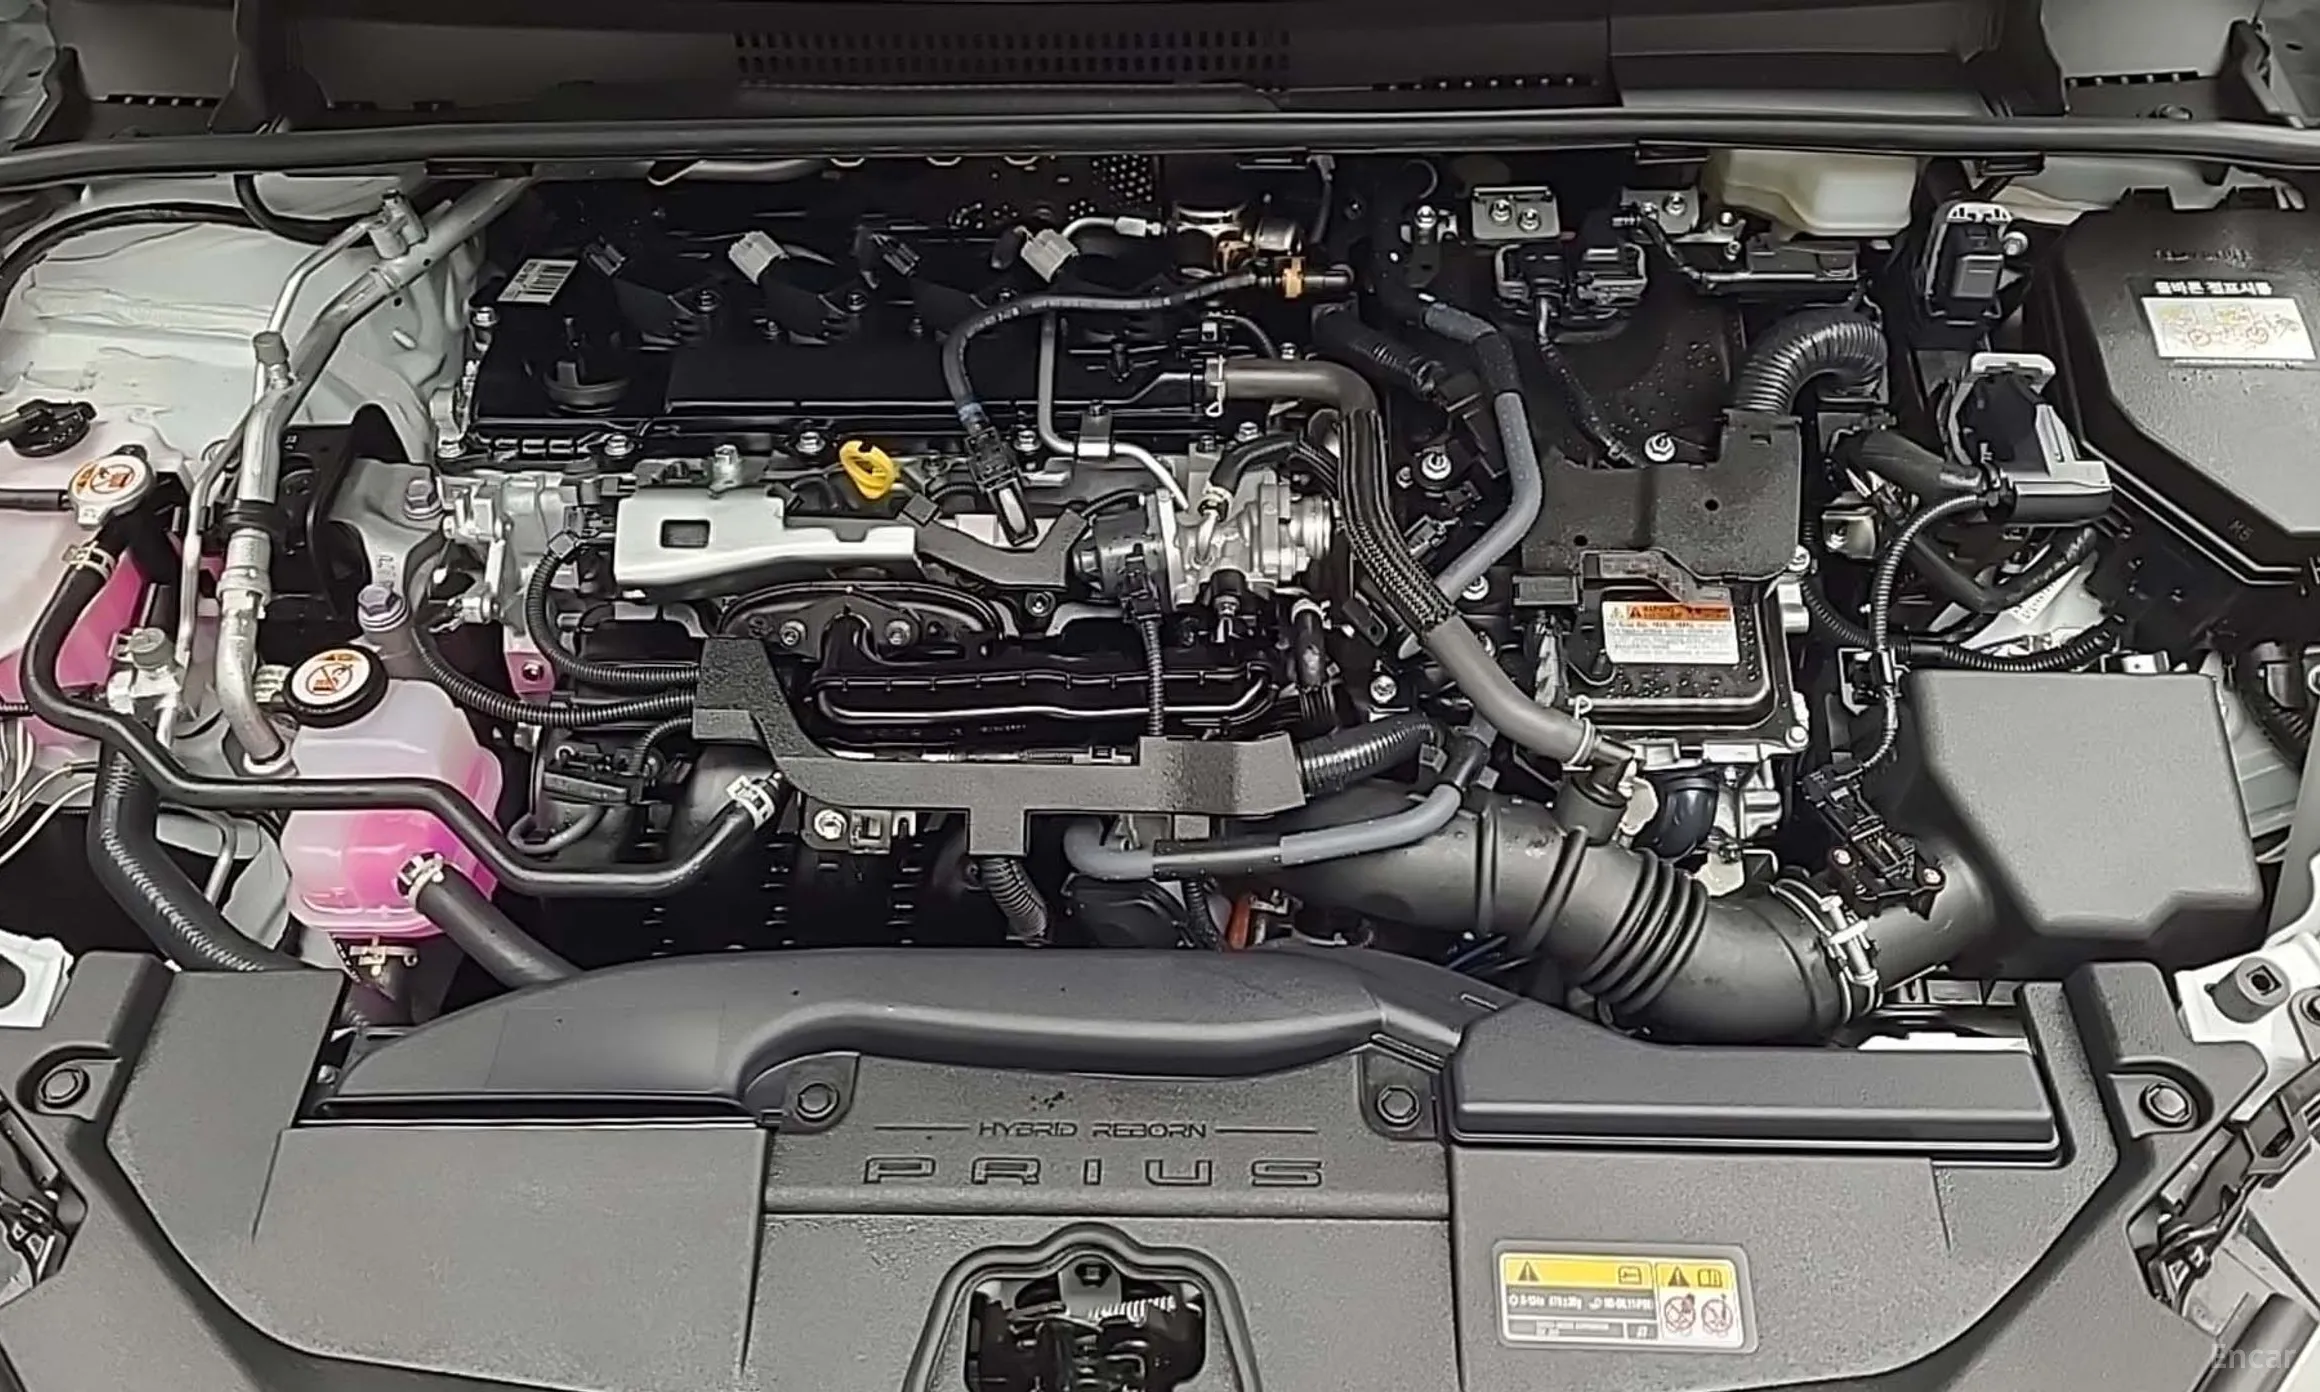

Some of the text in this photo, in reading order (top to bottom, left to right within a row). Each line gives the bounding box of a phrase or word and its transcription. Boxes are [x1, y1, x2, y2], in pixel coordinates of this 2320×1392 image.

[978, 1121, 1207, 1139] HYBRID REBORN
[862, 1156, 1323, 1188] PRIUS
